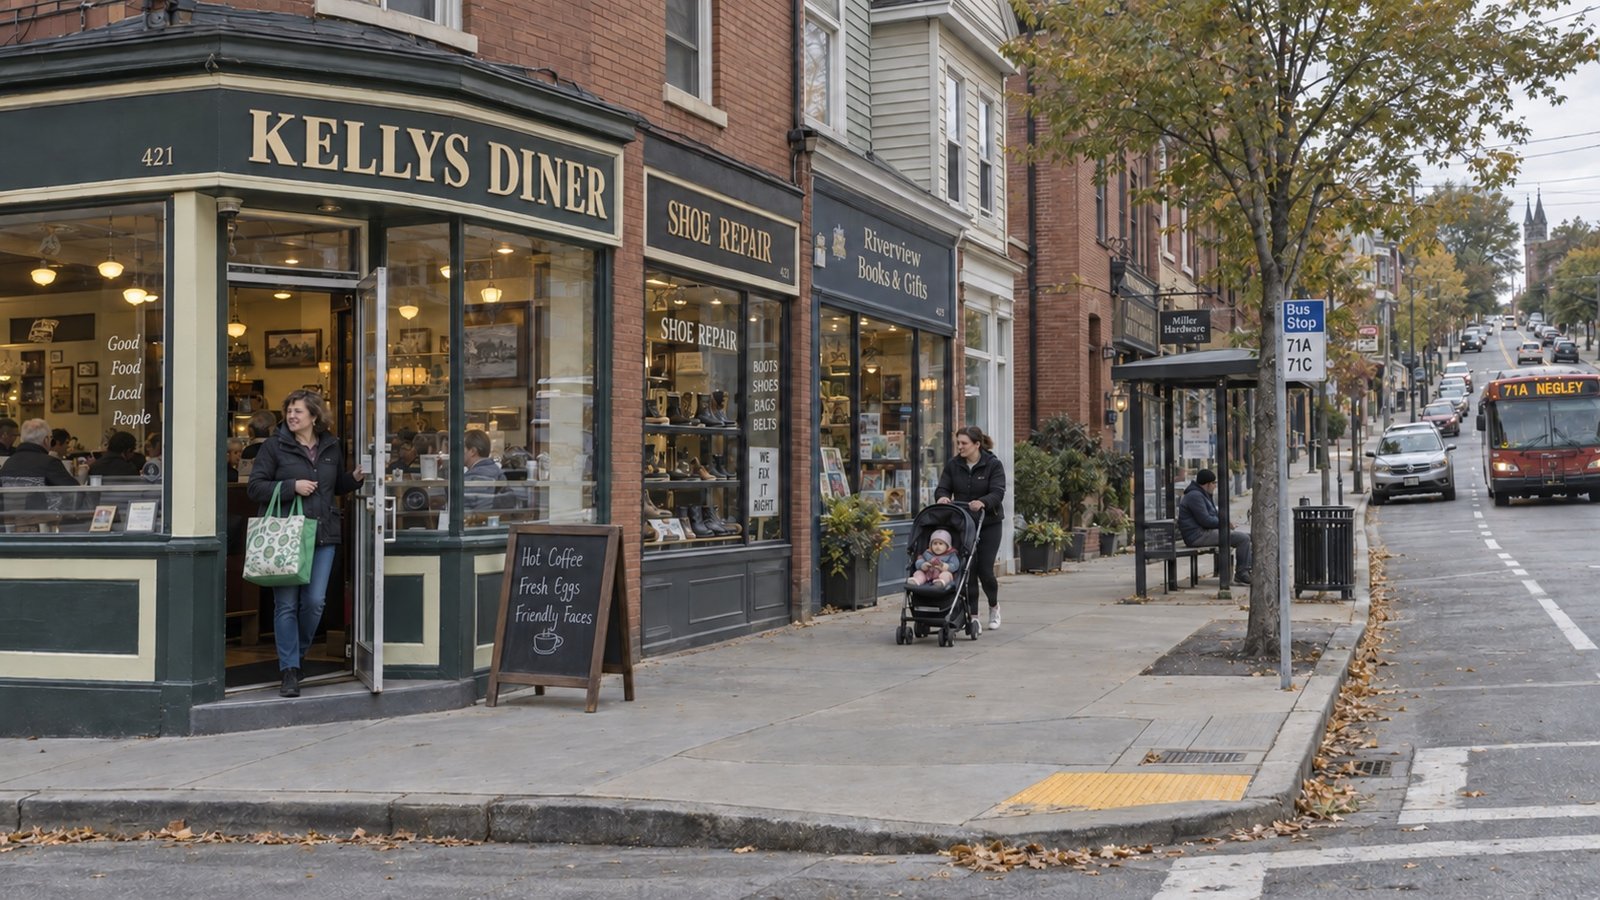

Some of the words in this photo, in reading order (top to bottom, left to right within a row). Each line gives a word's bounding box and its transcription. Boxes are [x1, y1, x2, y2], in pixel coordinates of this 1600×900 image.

[141, 145, 174, 167] 421
[248, 109, 470, 189] KELLYS
[487, 141, 608, 220] DINER
[667, 199, 712, 246] SHOE
[719, 216, 773, 264] REPAIR
[863, 226, 922, 268] Riverview
[857, 255, 891, 288] Books
[892, 269, 901, 291] &
[903, 272, 928, 301] Gifts
[1286, 303, 1311, 316] Bus
[1172, 315, 1198, 325] Miller
[1286, 316, 1317, 332] Stop
[660, 316, 695, 344] SHOE
[697, 323, 738, 351] REPAIR
[1164, 324, 1206, 334] Hardware
[107, 333, 141, 352] Good
[1286, 337, 1312, 353] 71A
[110, 357, 142, 376] Food
[753, 359, 779, 373] BOOTS
[1287, 356, 1313, 372] 71C
[108, 383, 143, 401] Local
[752, 379, 779, 393] SHOES
[1503, 383, 1529, 397] 71A
[1536, 381, 1584, 396] NEGLEY
[754, 398, 776, 412] BAGS
[112, 408, 152, 430] People
[753, 418, 777, 431] BELTS
[759, 451, 770, 463] WE
[758, 467, 770, 479] FIX
[760, 483, 768, 497] IT
[753, 499, 774, 512] RIGHT
[521, 547, 541, 568] Hot
[548, 546, 584, 570] Coffee
[519, 576, 548, 596] Fresh
[554, 576, 581, 603] Eggs
[515, 603, 559, 632] Friendly
[563, 605, 593, 625] Faces
